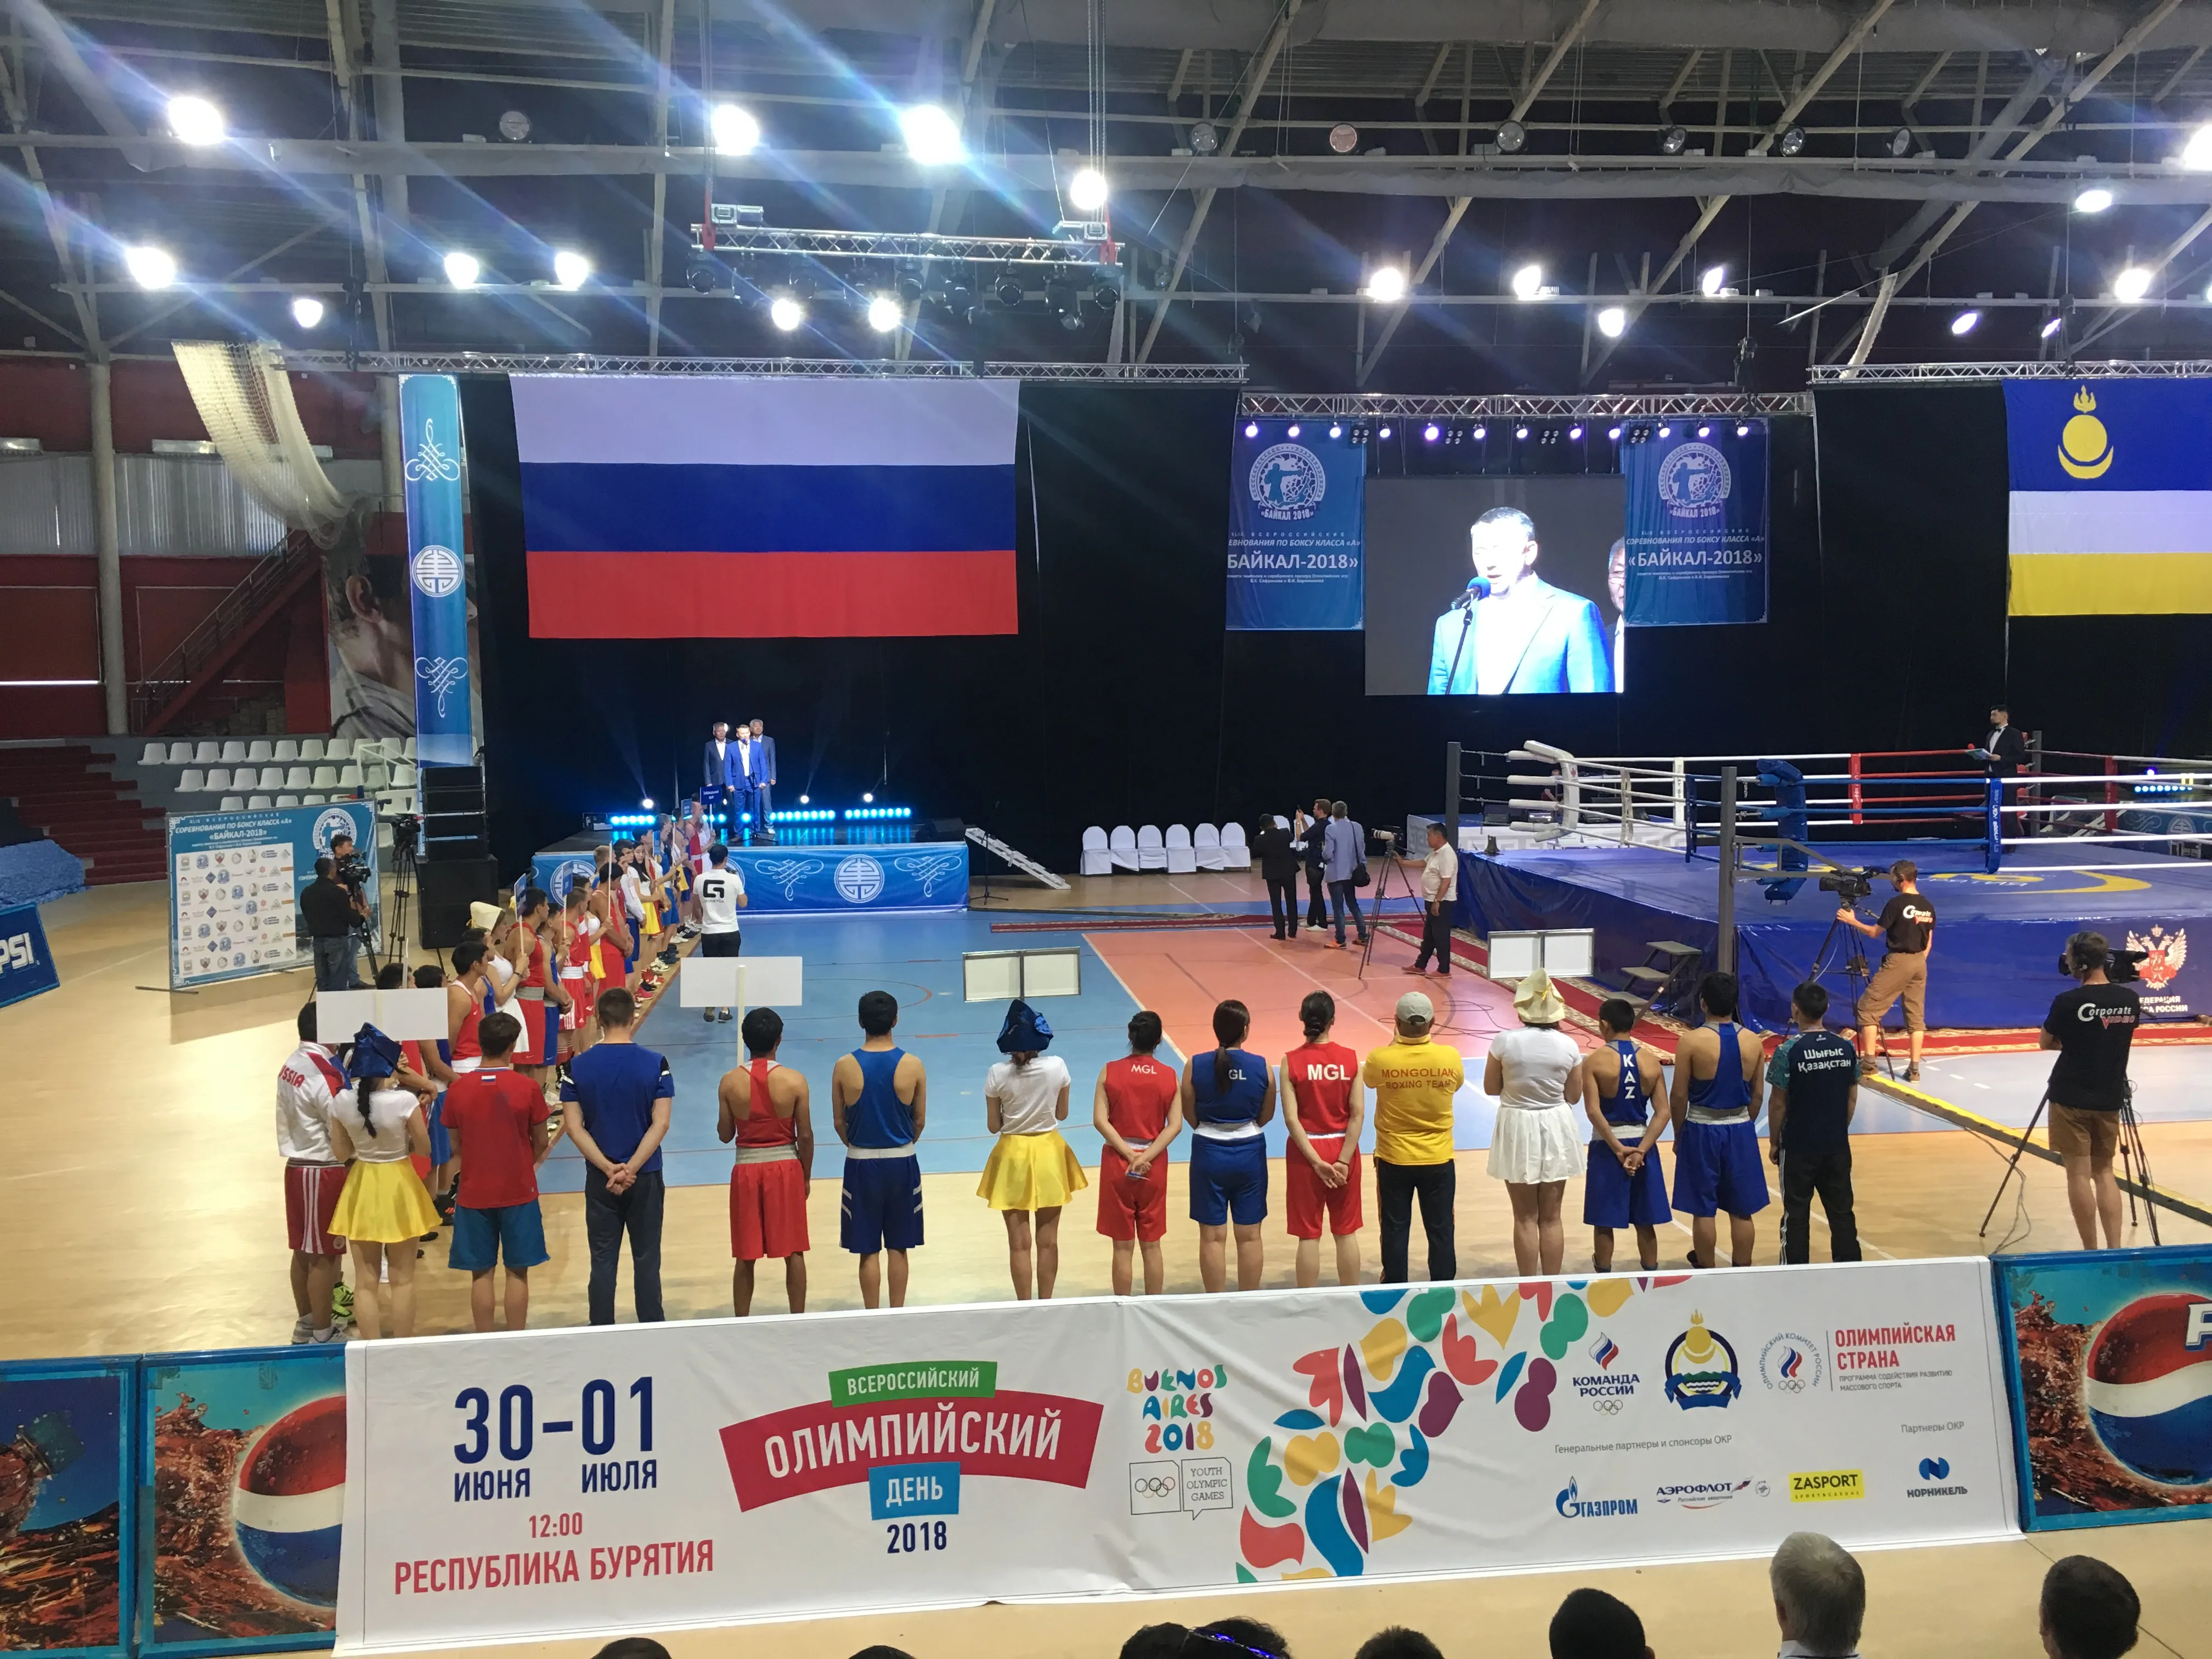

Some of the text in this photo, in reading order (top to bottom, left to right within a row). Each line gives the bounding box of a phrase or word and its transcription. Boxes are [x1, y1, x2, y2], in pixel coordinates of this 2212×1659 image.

[1626, 537, 1683, 545] СОРЕВНОВАНИЯ
[1628, 548, 1763, 567] «БАЙКАЛ-2018»
[209, 828, 267, 840] «БАЙКАЛ-2018»
[2155, 1005, 2188, 1013] РОССИИ
[2102, 1015, 2136, 1030] VIDEO
[1804, 1048, 1844, 1059] Шығыс
[1131, 1064, 1157, 1075] MGL
[1307, 1064, 1351, 1081] MGL
[1381, 1068, 1454, 1079] MONGOLIAN
[1798, 1059, 1852, 1073] Қазақстан
[1386, 1080, 1451, 1089] BOXING TEAM
[1835, 1322, 1956, 1348] ОЛИМПИЙСКАЯ
[1759, 1333, 1822, 1389] ОЛИМПИЙСКИЙ КОМИТЕТ РОССИИ
[1837, 1350, 1900, 1370] СТРАНА
[847, 1367, 980, 1396] ВСЕРОССИЙСКИЙ
[1127, 1364, 1227, 1393] BUENOS
[1572, 1374, 1640, 1387] КОМАНДА
[1878, 1372, 1918, 1380] СОДЕЙСТВИЯ
[1579, 1385, 1634, 1397] РОССИИ
[1143, 1393, 1213, 1421] AIRES
[1901, 1421, 1965, 1434] Партнеры ОКР
[764, 1400, 1062, 1480] ОЛИМПИЙСКИЙ
[1145, 1421, 1214, 1454] 2018
[1555, 1442, 1613, 1454] Генеральные
[1616, 1440, 1659, 1452] партнеры
[1669, 1437, 1712, 1448] спонсоры
[1714, 1435, 1732, 1444] ОКР
[1190, 1467, 1223, 1477] YOUTH
[454, 1459, 657, 1502] ИЮНЯ ИЮЛЯ
[1186, 1479, 1228, 1489] OLYMPIC
[1793, 1474, 1858, 1490] ZASPORT
[886, 1476, 944, 1508] ДЕНЬ
[1656, 1482, 1733, 1496] АЭРОФЛОТ
[1907, 1486, 1968, 1498] НОРНИКЕЛЬ
[1191, 1492, 1224, 1502] GAMES
[1581, 1498, 1638, 1517] ГАЗПРОМ
[529, 1512, 583, 1538] 12:00
[887, 1521, 947, 1554] 2018
[395, 1539, 714, 1594] РЕСПУБЛИКА БУРЯТИЯ
